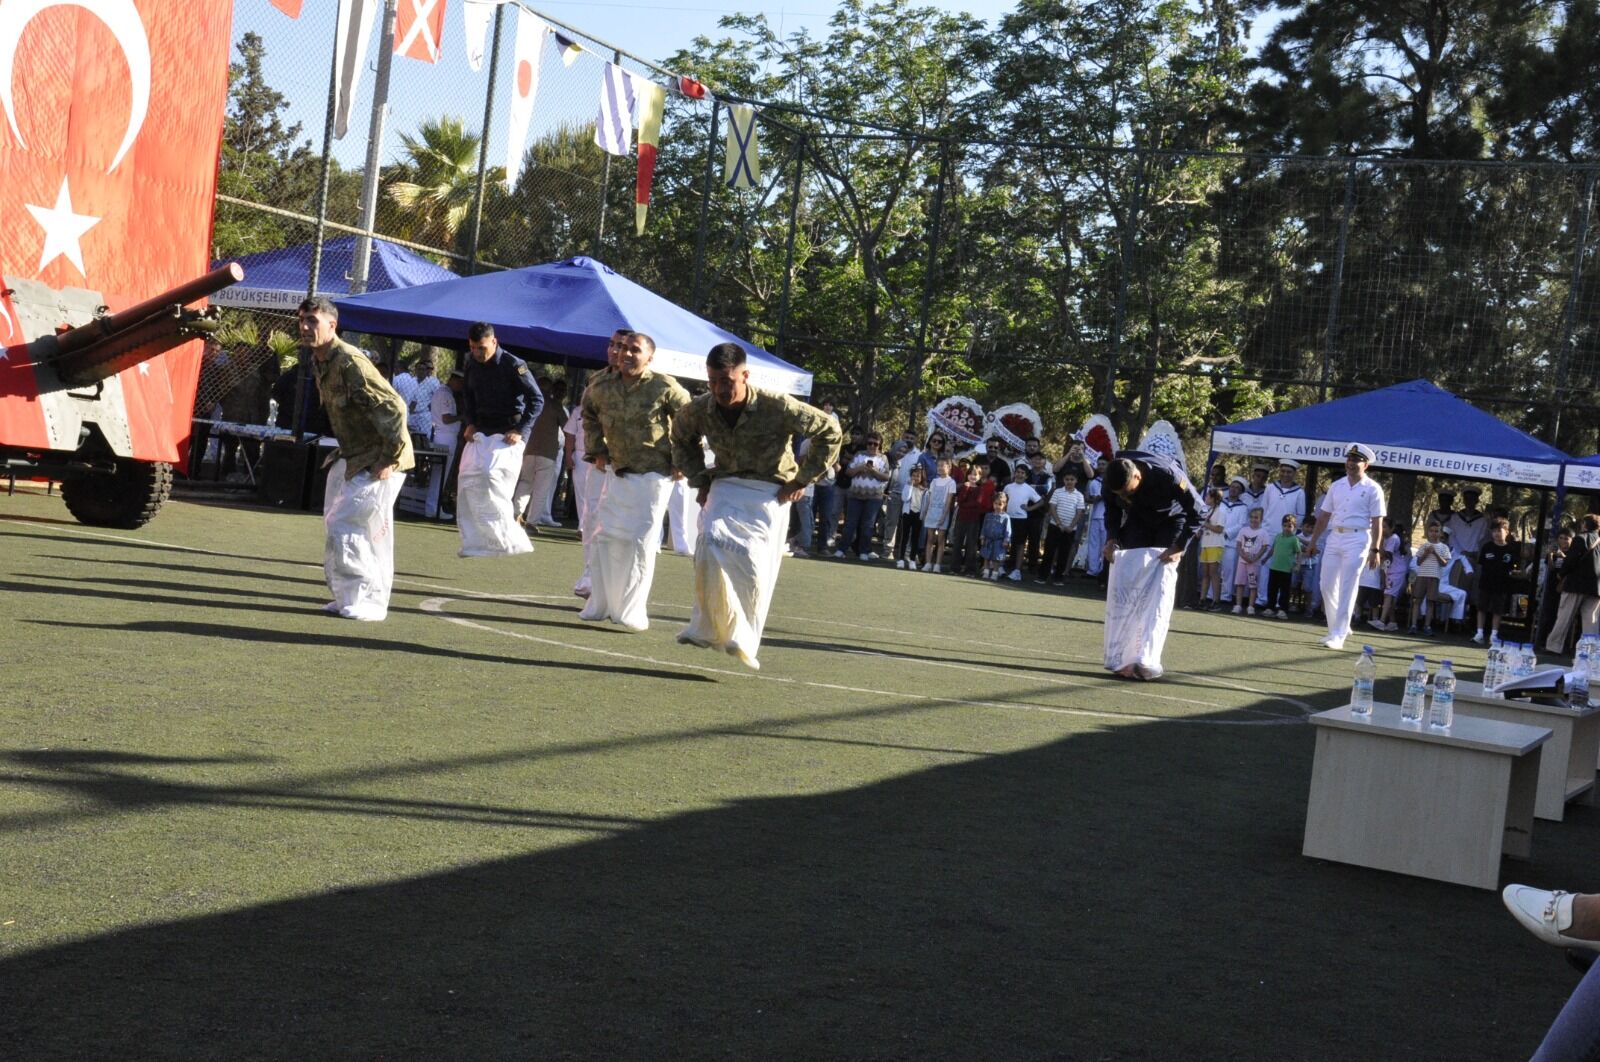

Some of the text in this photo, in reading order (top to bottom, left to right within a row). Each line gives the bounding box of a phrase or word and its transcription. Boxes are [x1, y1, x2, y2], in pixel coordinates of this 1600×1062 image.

[220, 288, 288, 304] BÜYÜKŞEHİR
[1296, 445, 1330, 456] AYDIN
[1425, 458, 1492, 473] BELEDİYESİ
